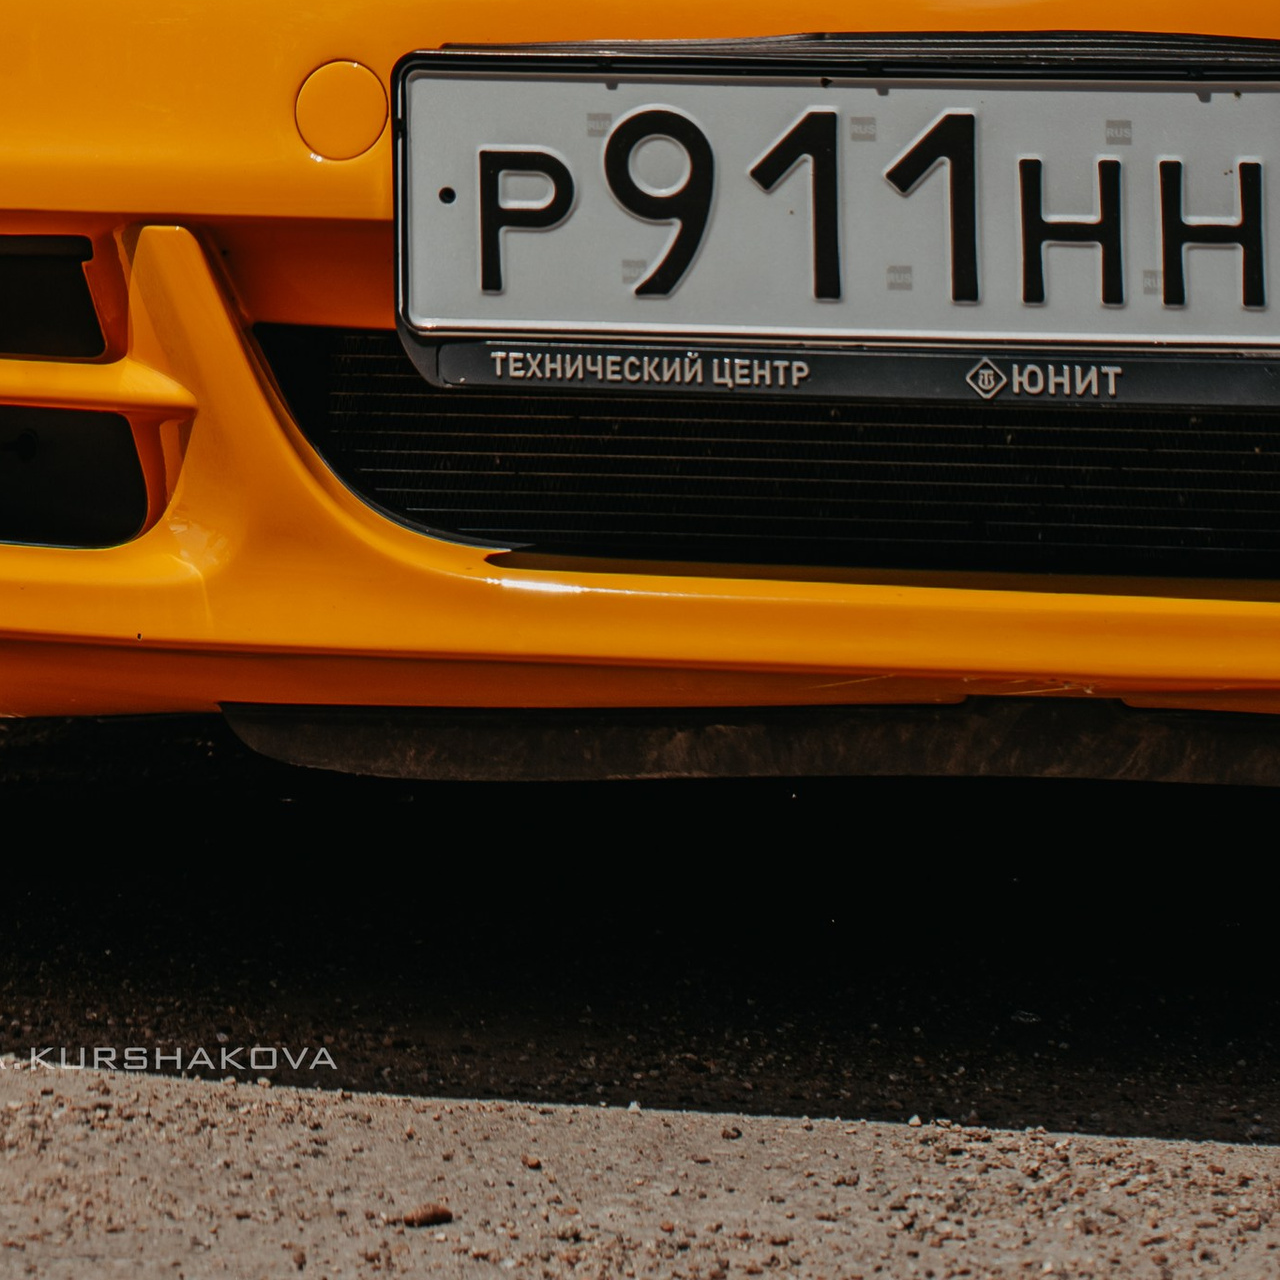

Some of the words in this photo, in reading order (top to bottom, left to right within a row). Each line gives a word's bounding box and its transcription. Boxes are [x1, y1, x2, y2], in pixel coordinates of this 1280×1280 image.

[851, 124, 877, 135] RUS
[1106, 128, 1131, 138] RUS
[888, 273, 912, 283] RUS
[490, 350, 704, 384] ТЕХНИЧЕСКИЙ
[712, 357, 811, 388] ЦЕНТР
[1012, 363, 1122, 396] ЮНИТ
